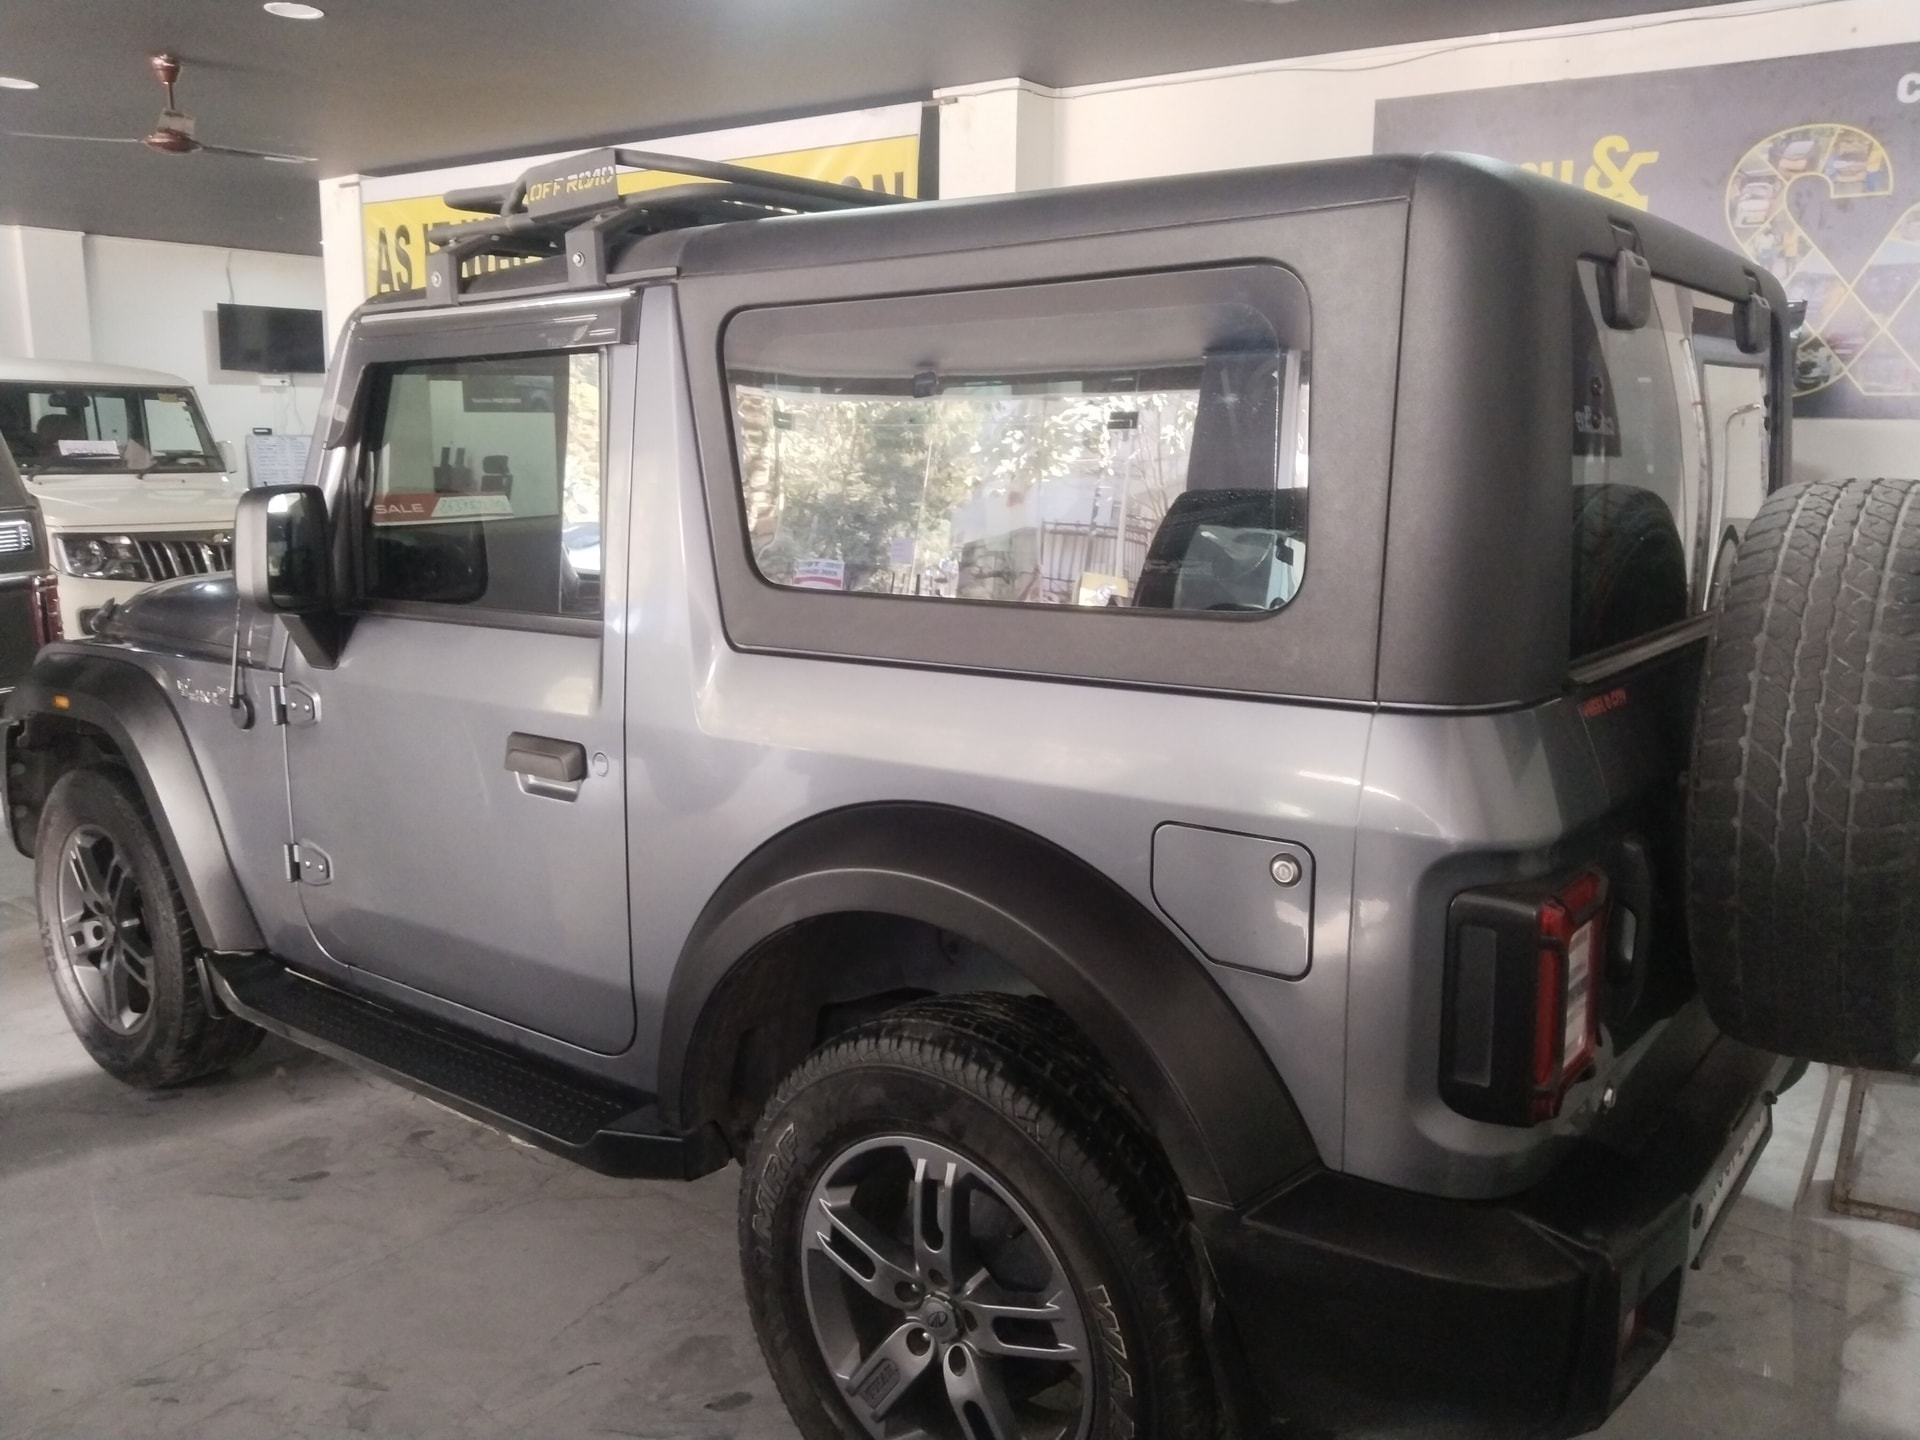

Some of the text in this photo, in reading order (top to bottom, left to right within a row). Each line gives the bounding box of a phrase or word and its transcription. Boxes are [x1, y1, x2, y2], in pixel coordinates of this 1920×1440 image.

[529, 166, 614, 201] OFF ROAD
[374, 503, 424, 515] SALE
[753, 1122, 798, 1246] MRF
